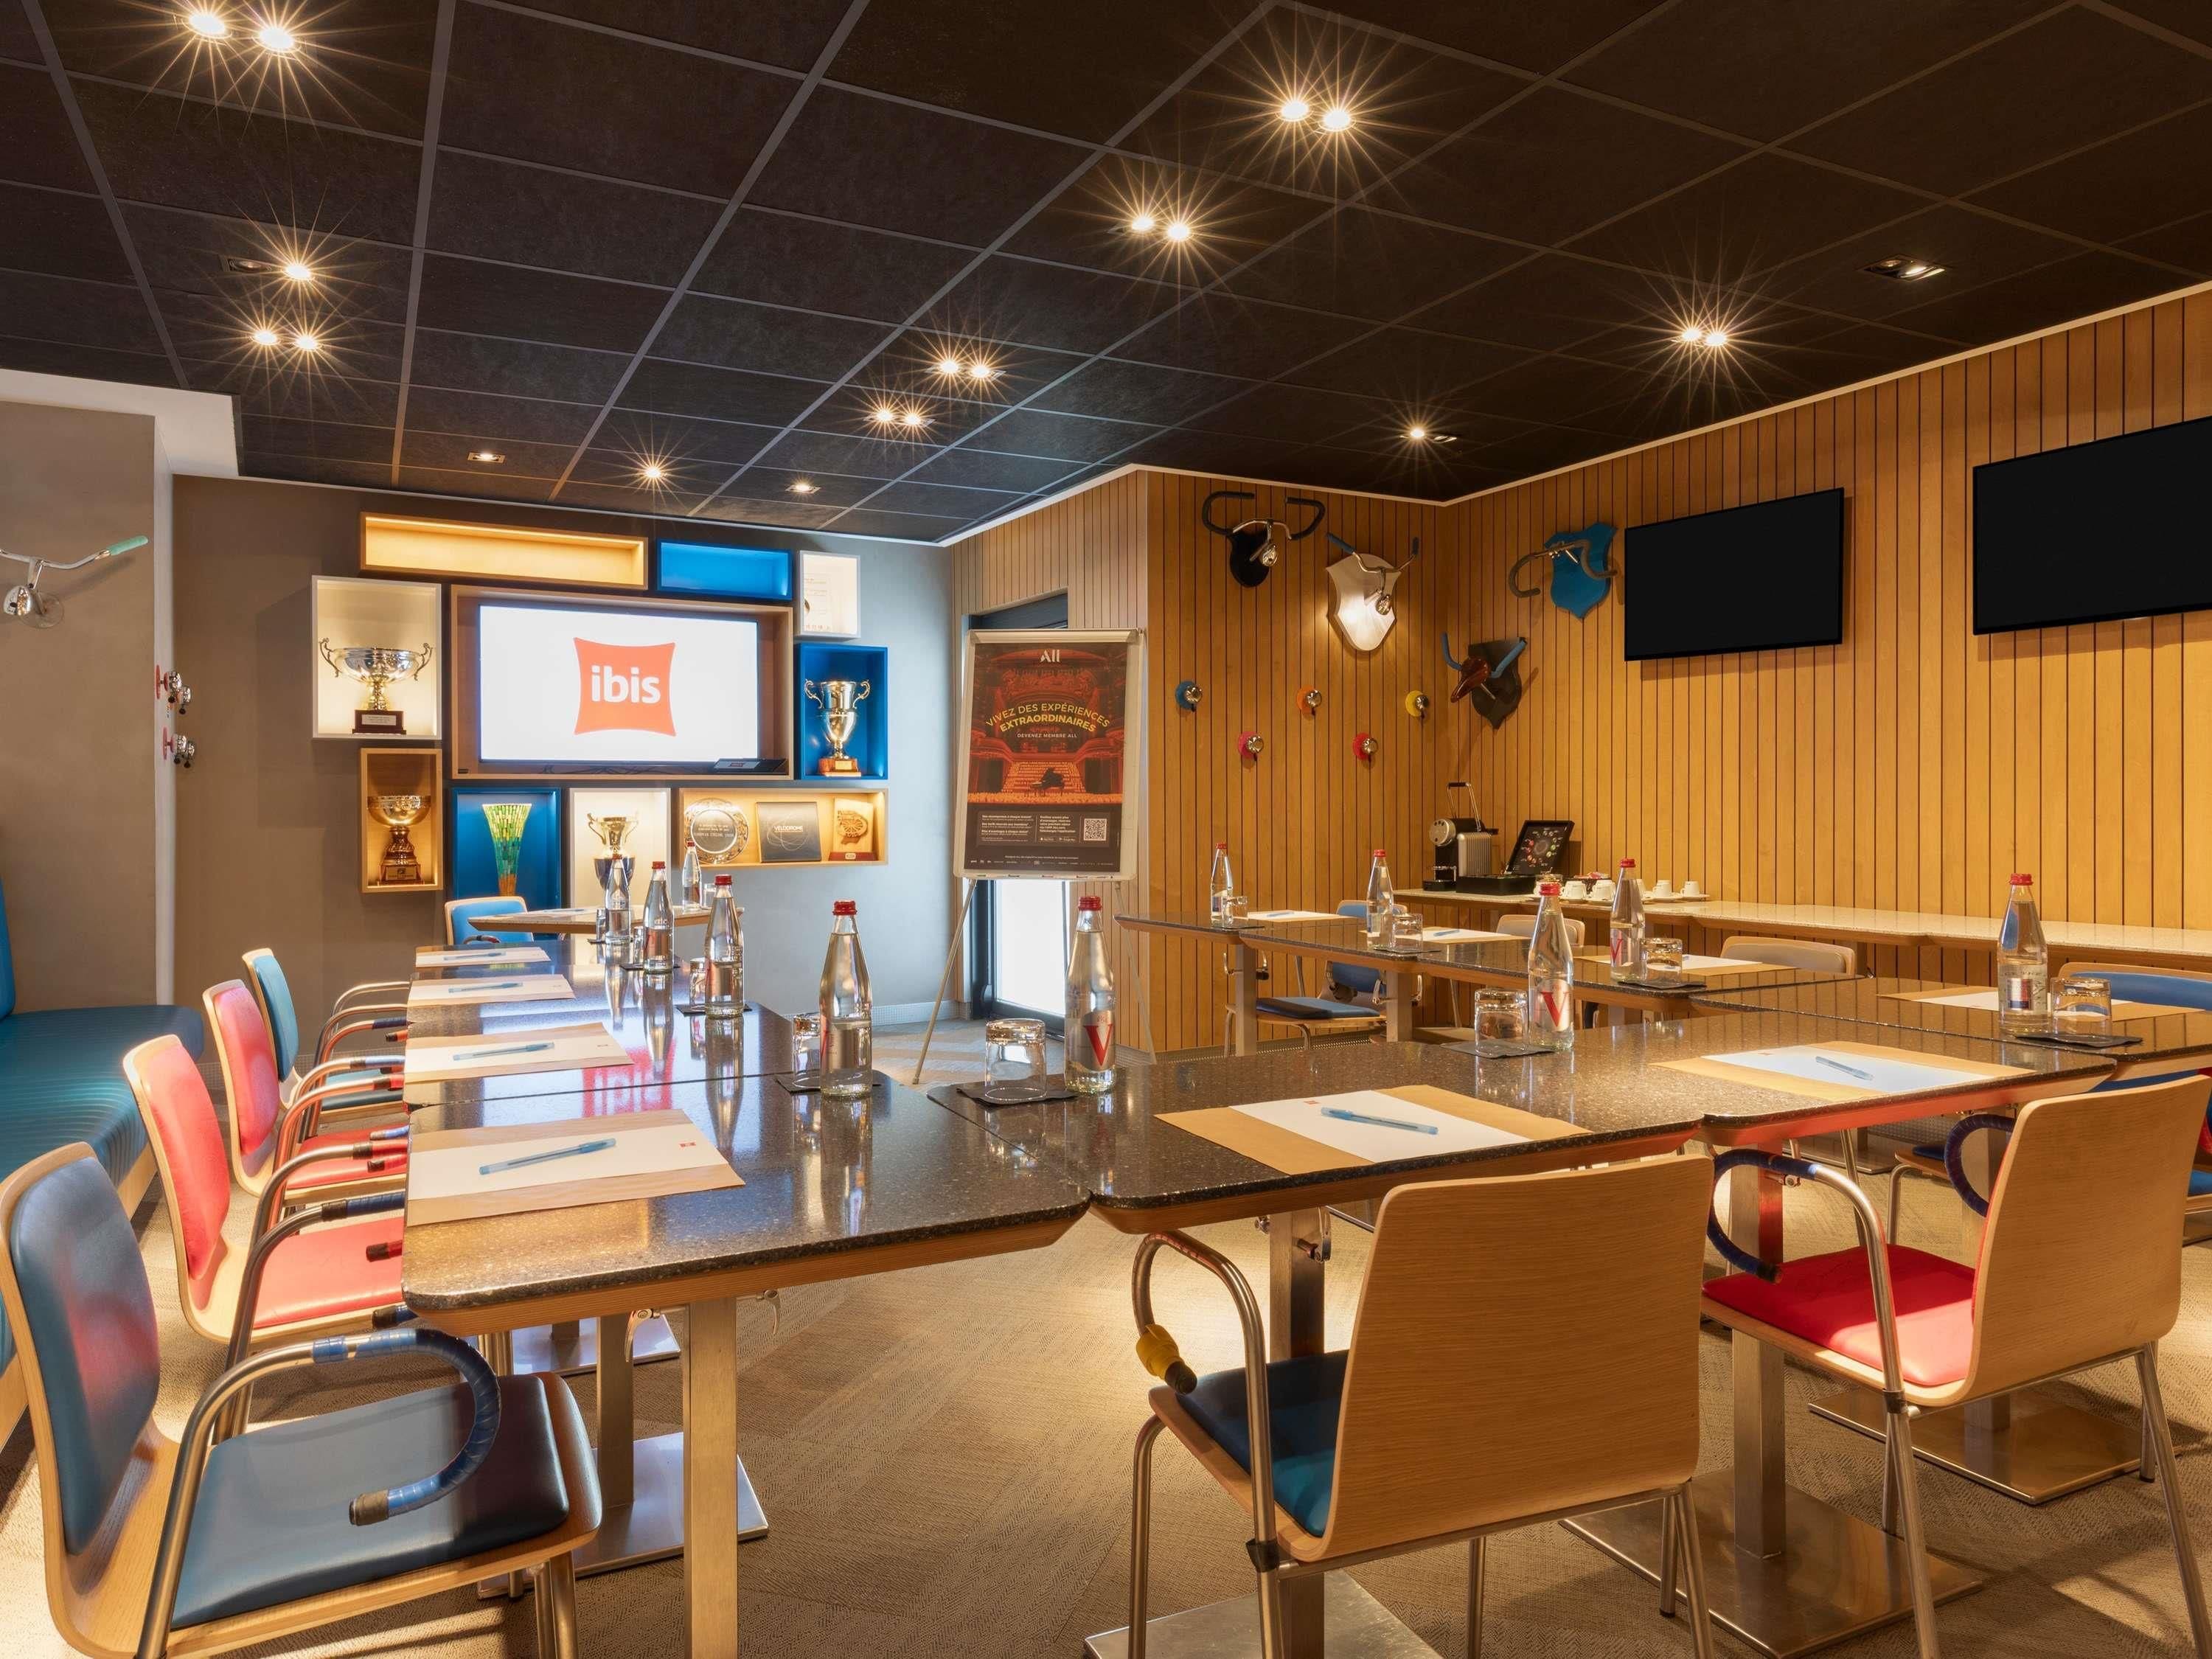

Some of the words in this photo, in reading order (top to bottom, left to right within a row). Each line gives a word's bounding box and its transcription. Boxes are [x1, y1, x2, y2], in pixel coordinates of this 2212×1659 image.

[591, 665, 661, 704] ibis
[986, 708, 1016, 727] VIVEZ
[1018, 703, 1038, 714] DES
[1041, 702, 1110, 728] EXPÉRIENCES
[999, 714, 1097, 732] EXTRAORDINAIRES
